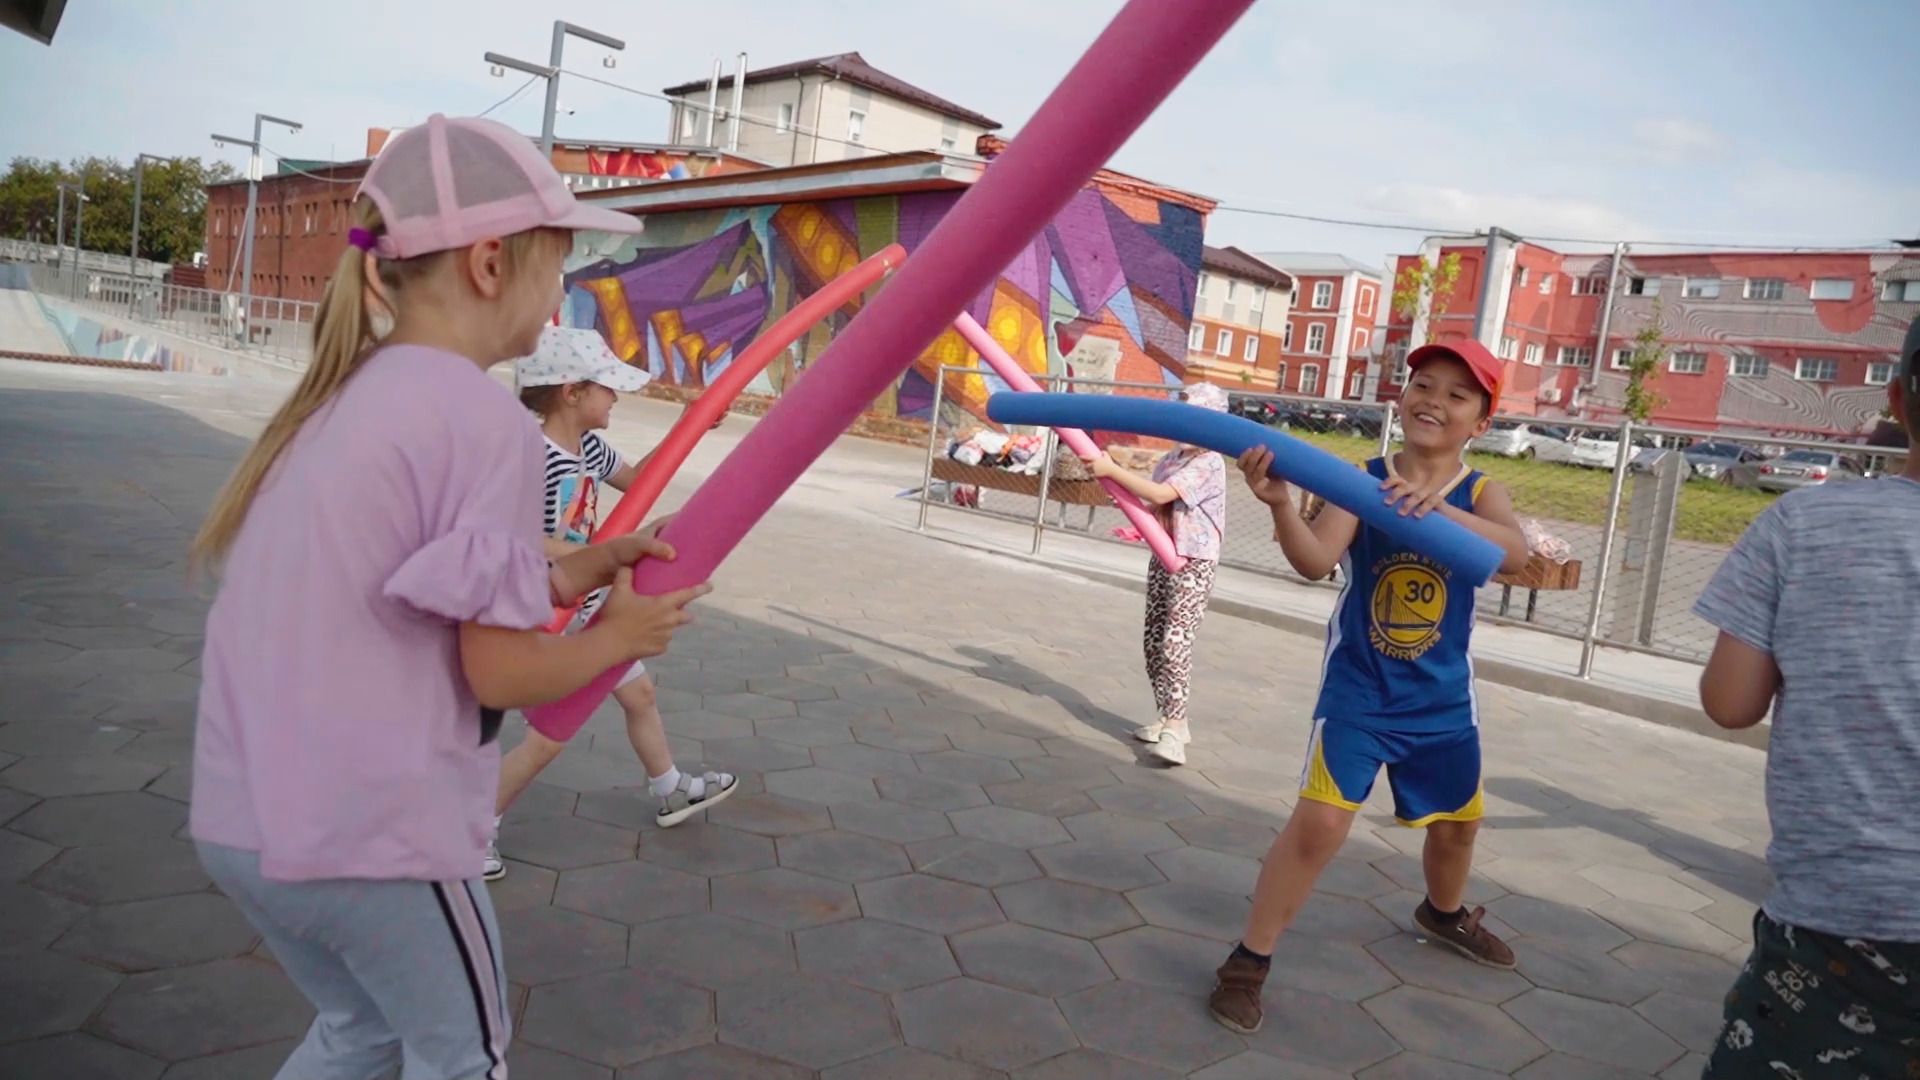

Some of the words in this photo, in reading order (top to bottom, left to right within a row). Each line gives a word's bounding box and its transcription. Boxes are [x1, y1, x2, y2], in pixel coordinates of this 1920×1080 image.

[1372, 552, 1418, 574] GOLDEN
[1423, 556, 1452, 580] STATE
[1404, 580, 1435, 603] 30
[1369, 625, 1441, 661] WARRIORS
[1765, 969, 1806, 1013] SKATE
[1782, 970, 1804, 991] GO
